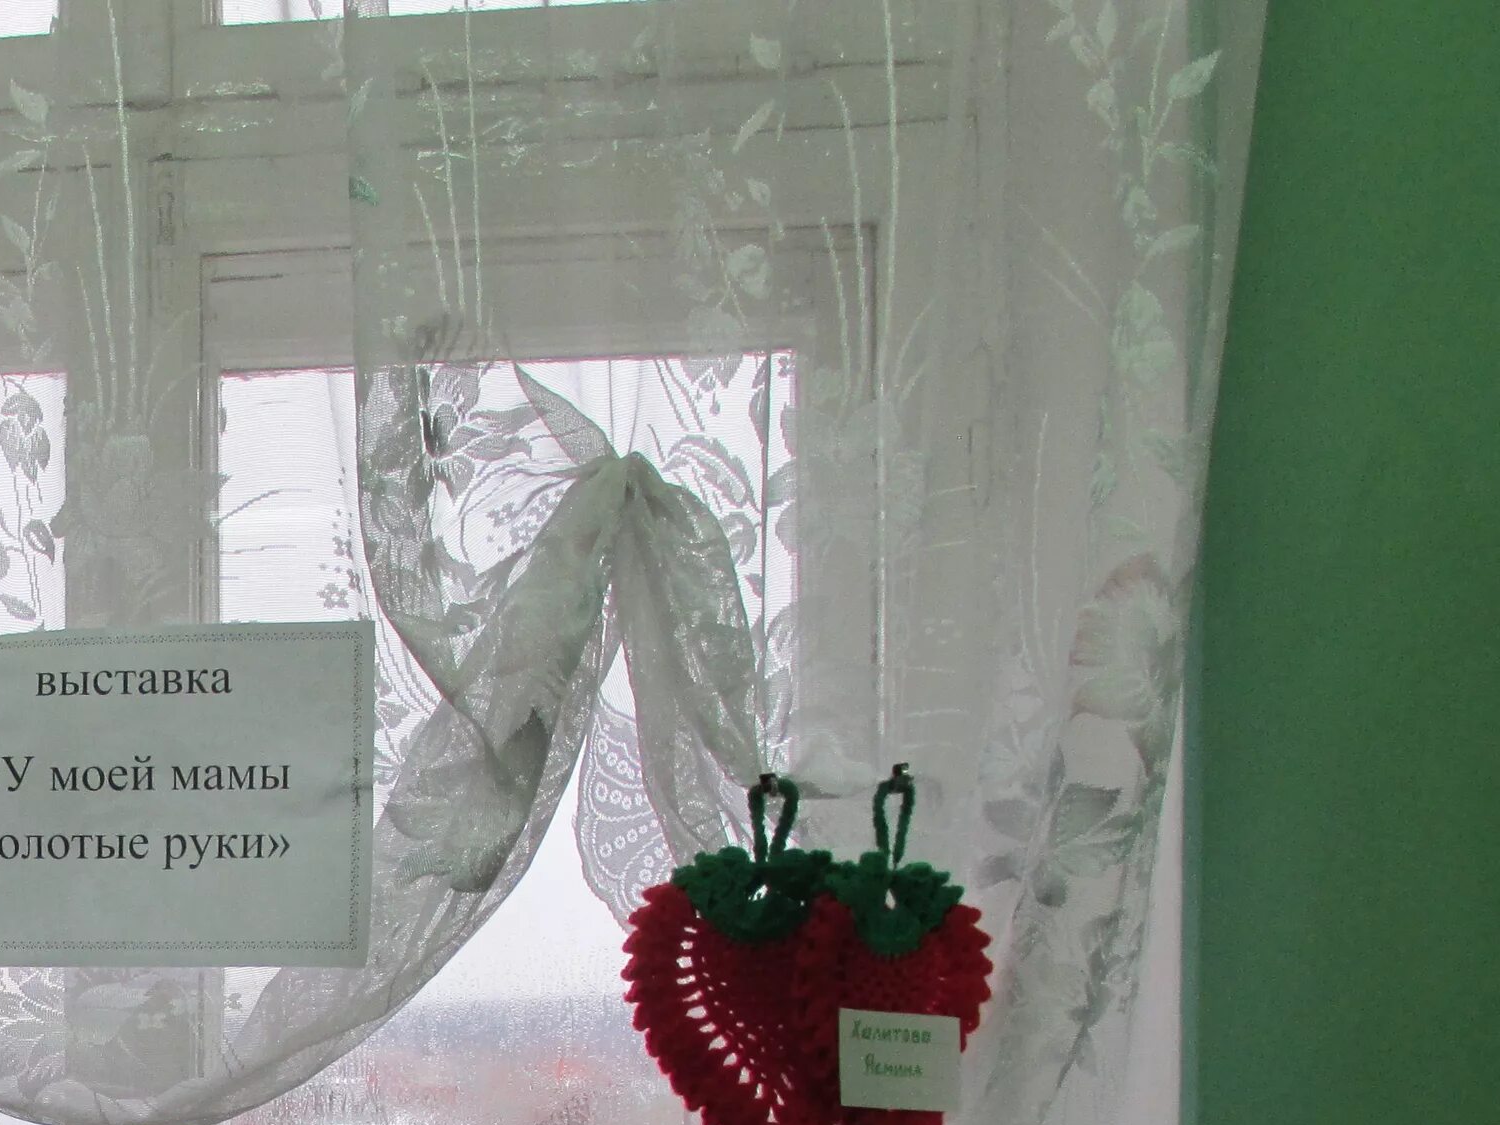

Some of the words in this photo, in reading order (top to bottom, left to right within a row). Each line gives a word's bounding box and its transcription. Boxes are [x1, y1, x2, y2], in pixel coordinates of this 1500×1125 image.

[35, 667, 233, 698] выставка
[50, 755, 156, 791] моей
[171, 764, 291, 791] мамы
[162, 832, 291, 870] руки»
